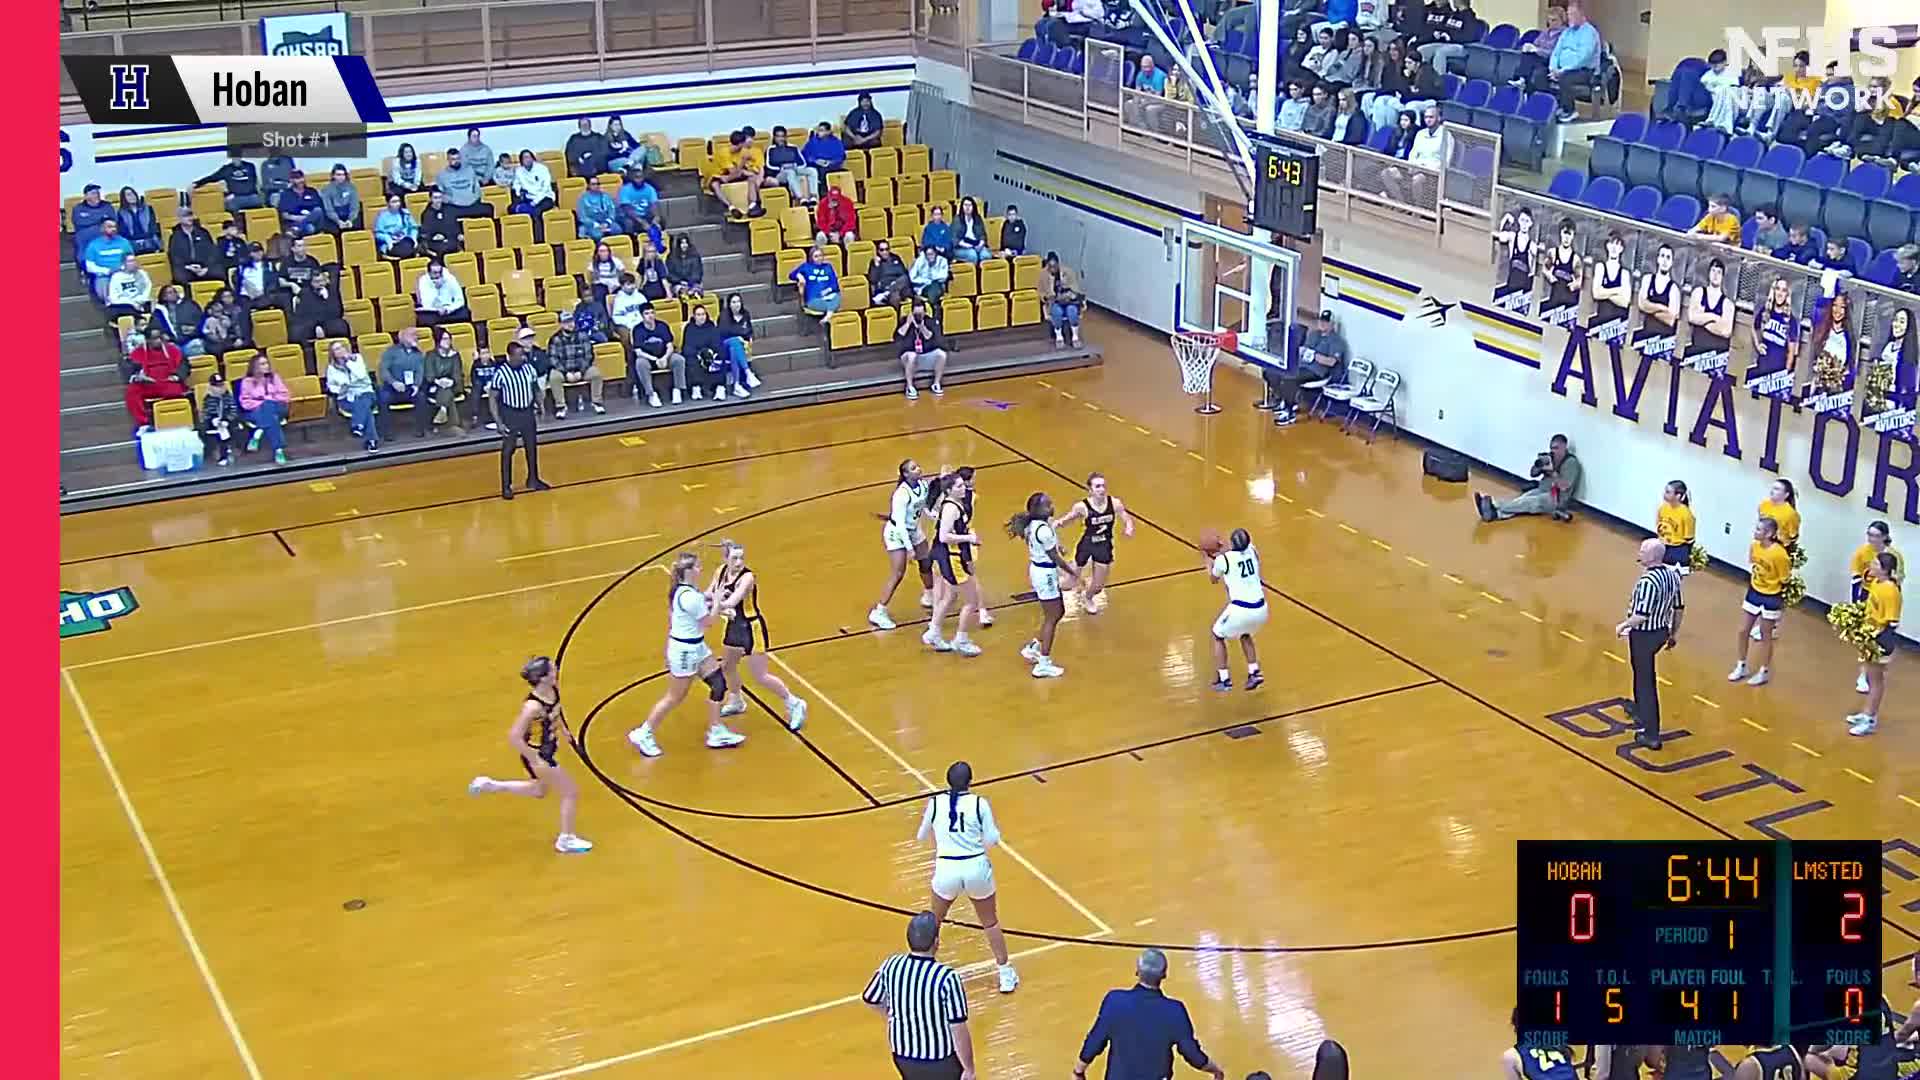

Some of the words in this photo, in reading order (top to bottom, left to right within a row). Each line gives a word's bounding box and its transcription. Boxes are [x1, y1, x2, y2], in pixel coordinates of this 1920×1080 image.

[1268, 155, 1301, 185] 6:43
[1238, 558, 1255, 578] 20
[948, 811, 965, 833] 21
[1547, 861, 1602, 881] HOBAN
[1667, 854, 1759, 903] 6:44
[1570, 893, 1596, 940] 0
[1840, 893, 1865, 940] 2
[1655, 926, 1710, 944] PERIOD
[1728, 919, 1735, 950] 1
[1524, 969, 1569, 985] FOULS
[1650, 969, 1706, 985] PLAYER
[1711, 969, 1746, 985] FOUL
[1826, 969, 1872, 985] FOULS
[1555, 990, 1561, 1021] 1
[1605, 988, 1624, 1023] 5
[1680, 990, 1699, 1020] 4
[1732, 990, 1738, 1020] 1
[1845, 987, 1864, 1022] 0
[1674, 1030, 1722, 1046] MATCH
[1825, 1030, 1872, 1045] SCORE
